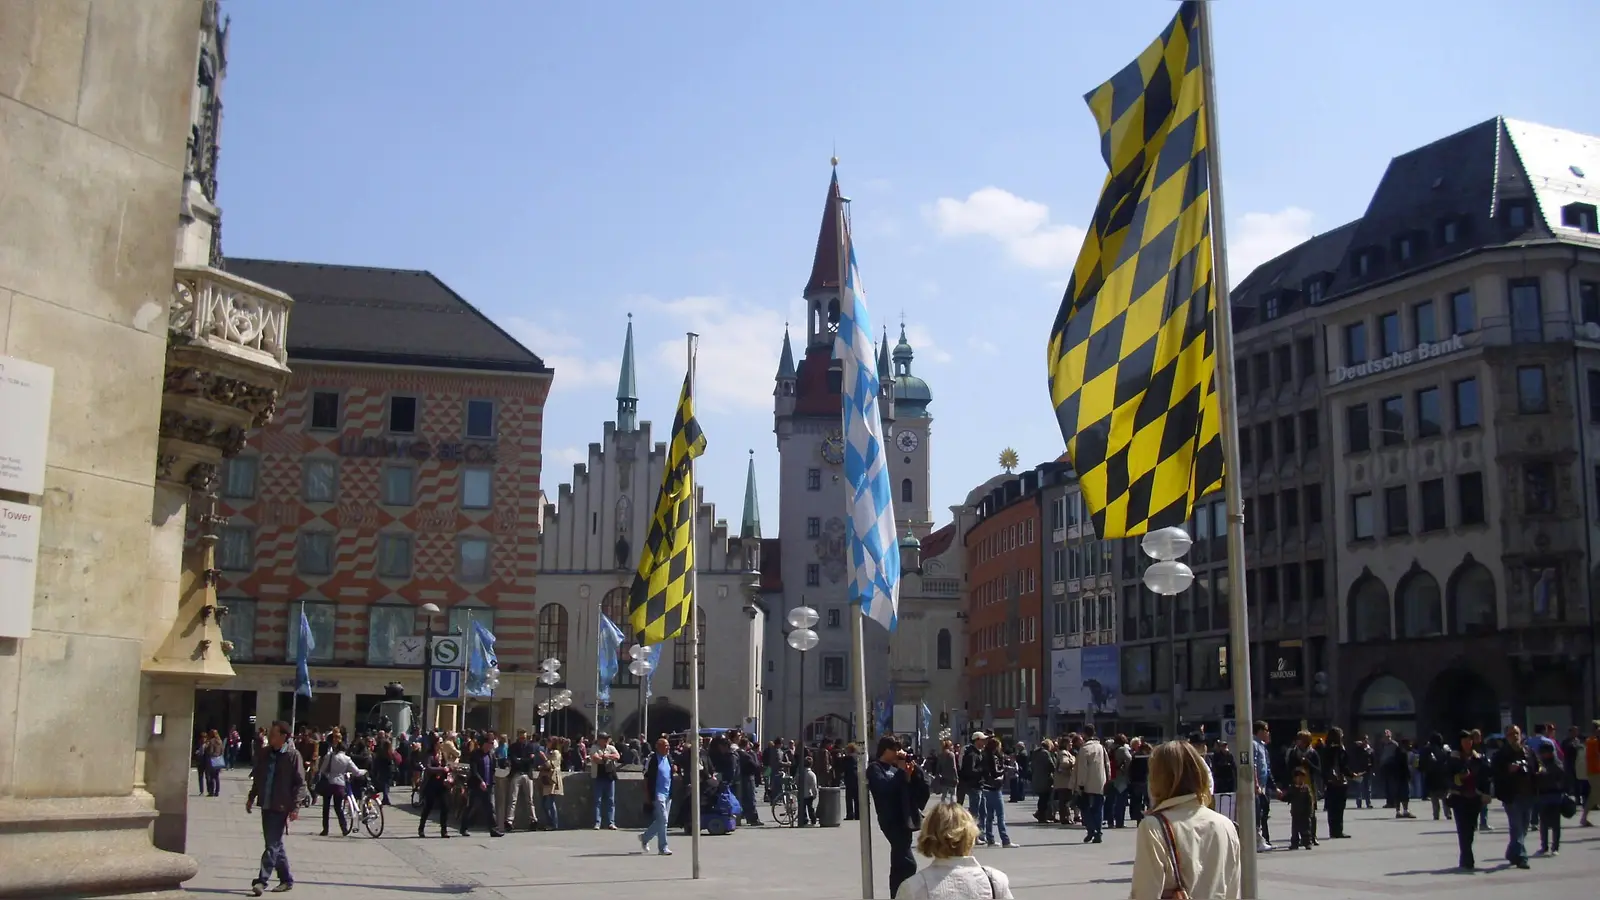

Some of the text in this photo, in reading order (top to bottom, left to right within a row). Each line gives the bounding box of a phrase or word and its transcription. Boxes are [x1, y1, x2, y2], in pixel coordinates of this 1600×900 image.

[1336, 334, 1464, 381] Deutsche Bank
[340, 436, 498, 464] LUDWIG BECK
[3, 508, 32, 522] Tower
[434, 671, 456, 696] U
